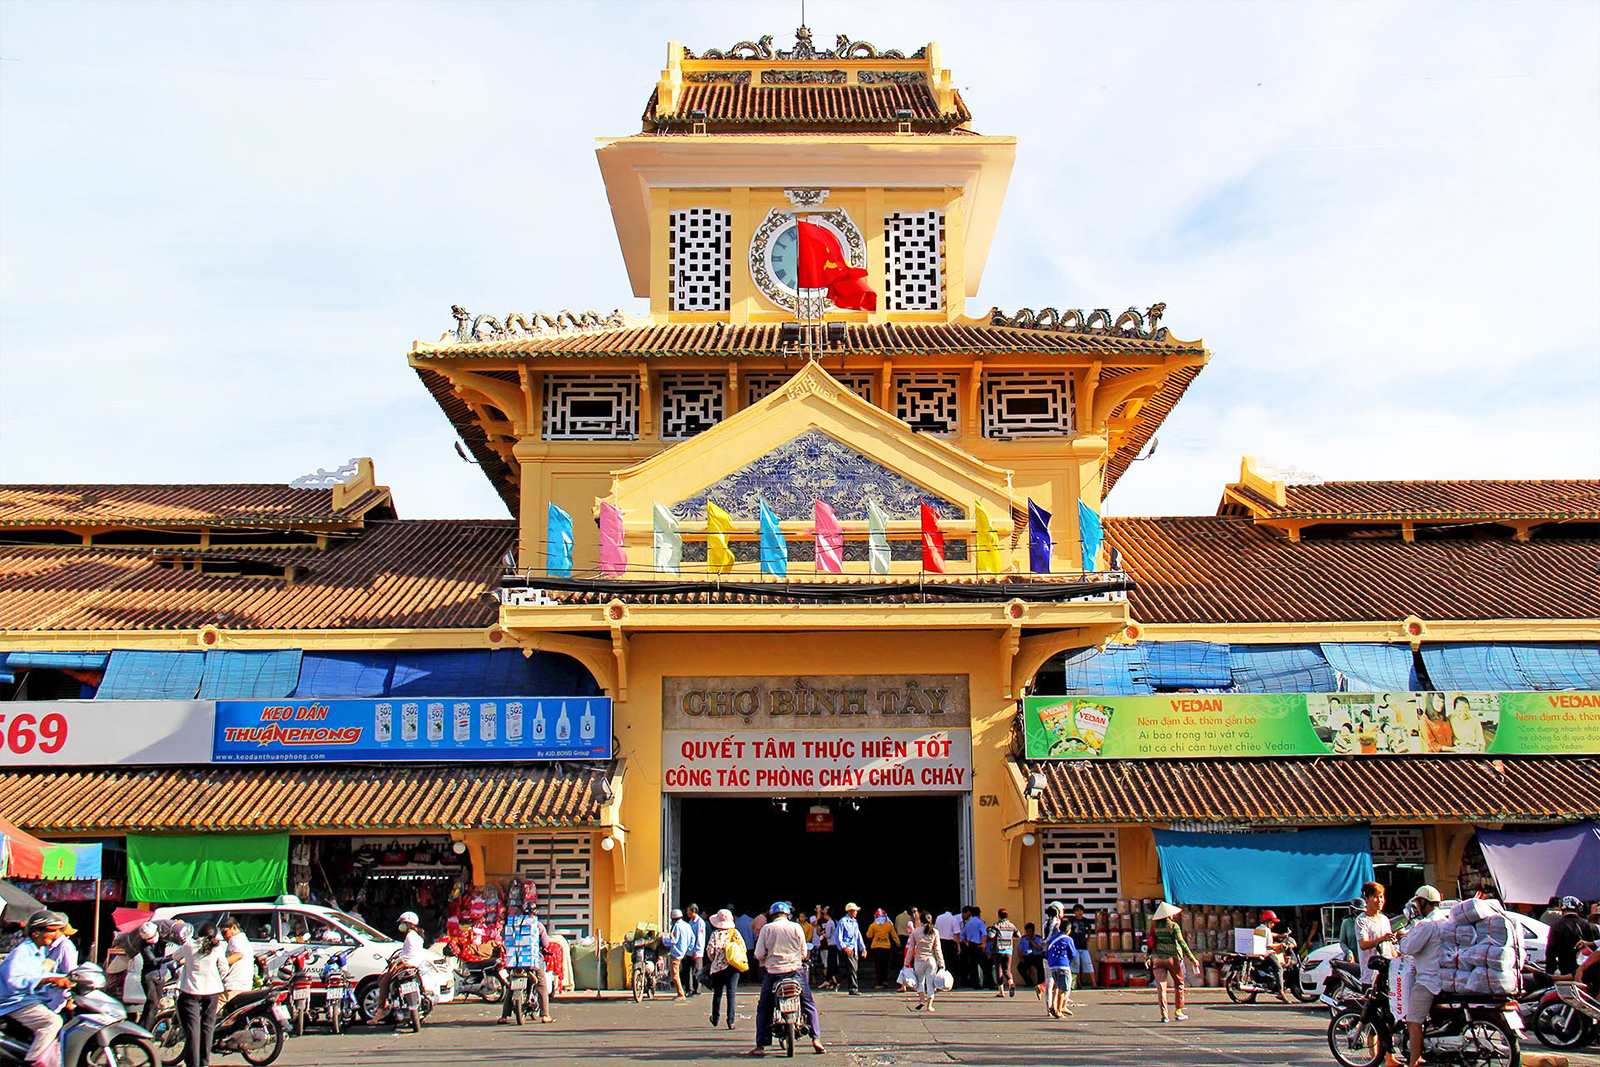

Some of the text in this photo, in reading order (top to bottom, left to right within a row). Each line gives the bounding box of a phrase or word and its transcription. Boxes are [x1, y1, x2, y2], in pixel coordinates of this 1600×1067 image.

[682, 680, 949, 724] CHỢ BÌNH TÂY
[1170, 699, 1223, 713] VEDAN
[1548, 695, 1600, 708] VEDAN
[260, 702, 330, 721] KEO DÁN
[380, 706, 392, 717] 502
[406, 706, 418, 717] 502
[432, 709, 444, 719] 502
[458, 706, 470, 717] 502
[1079, 712, 1107, 725] VEDAN
[0, 712, 68, 755] 69
[1138, 731, 1149, 740] Ai
[681, 733, 952, 762] QUYẾT TÂM THỰC HIỆN TỐT
[215, 753, 326, 761] www.keodanthuanphong.com
[665, 763, 966, 787] CÔNG TÁC PHÒNG CHÁY CHỮA CHÁY
[979, 795, 1000, 807] 57A
